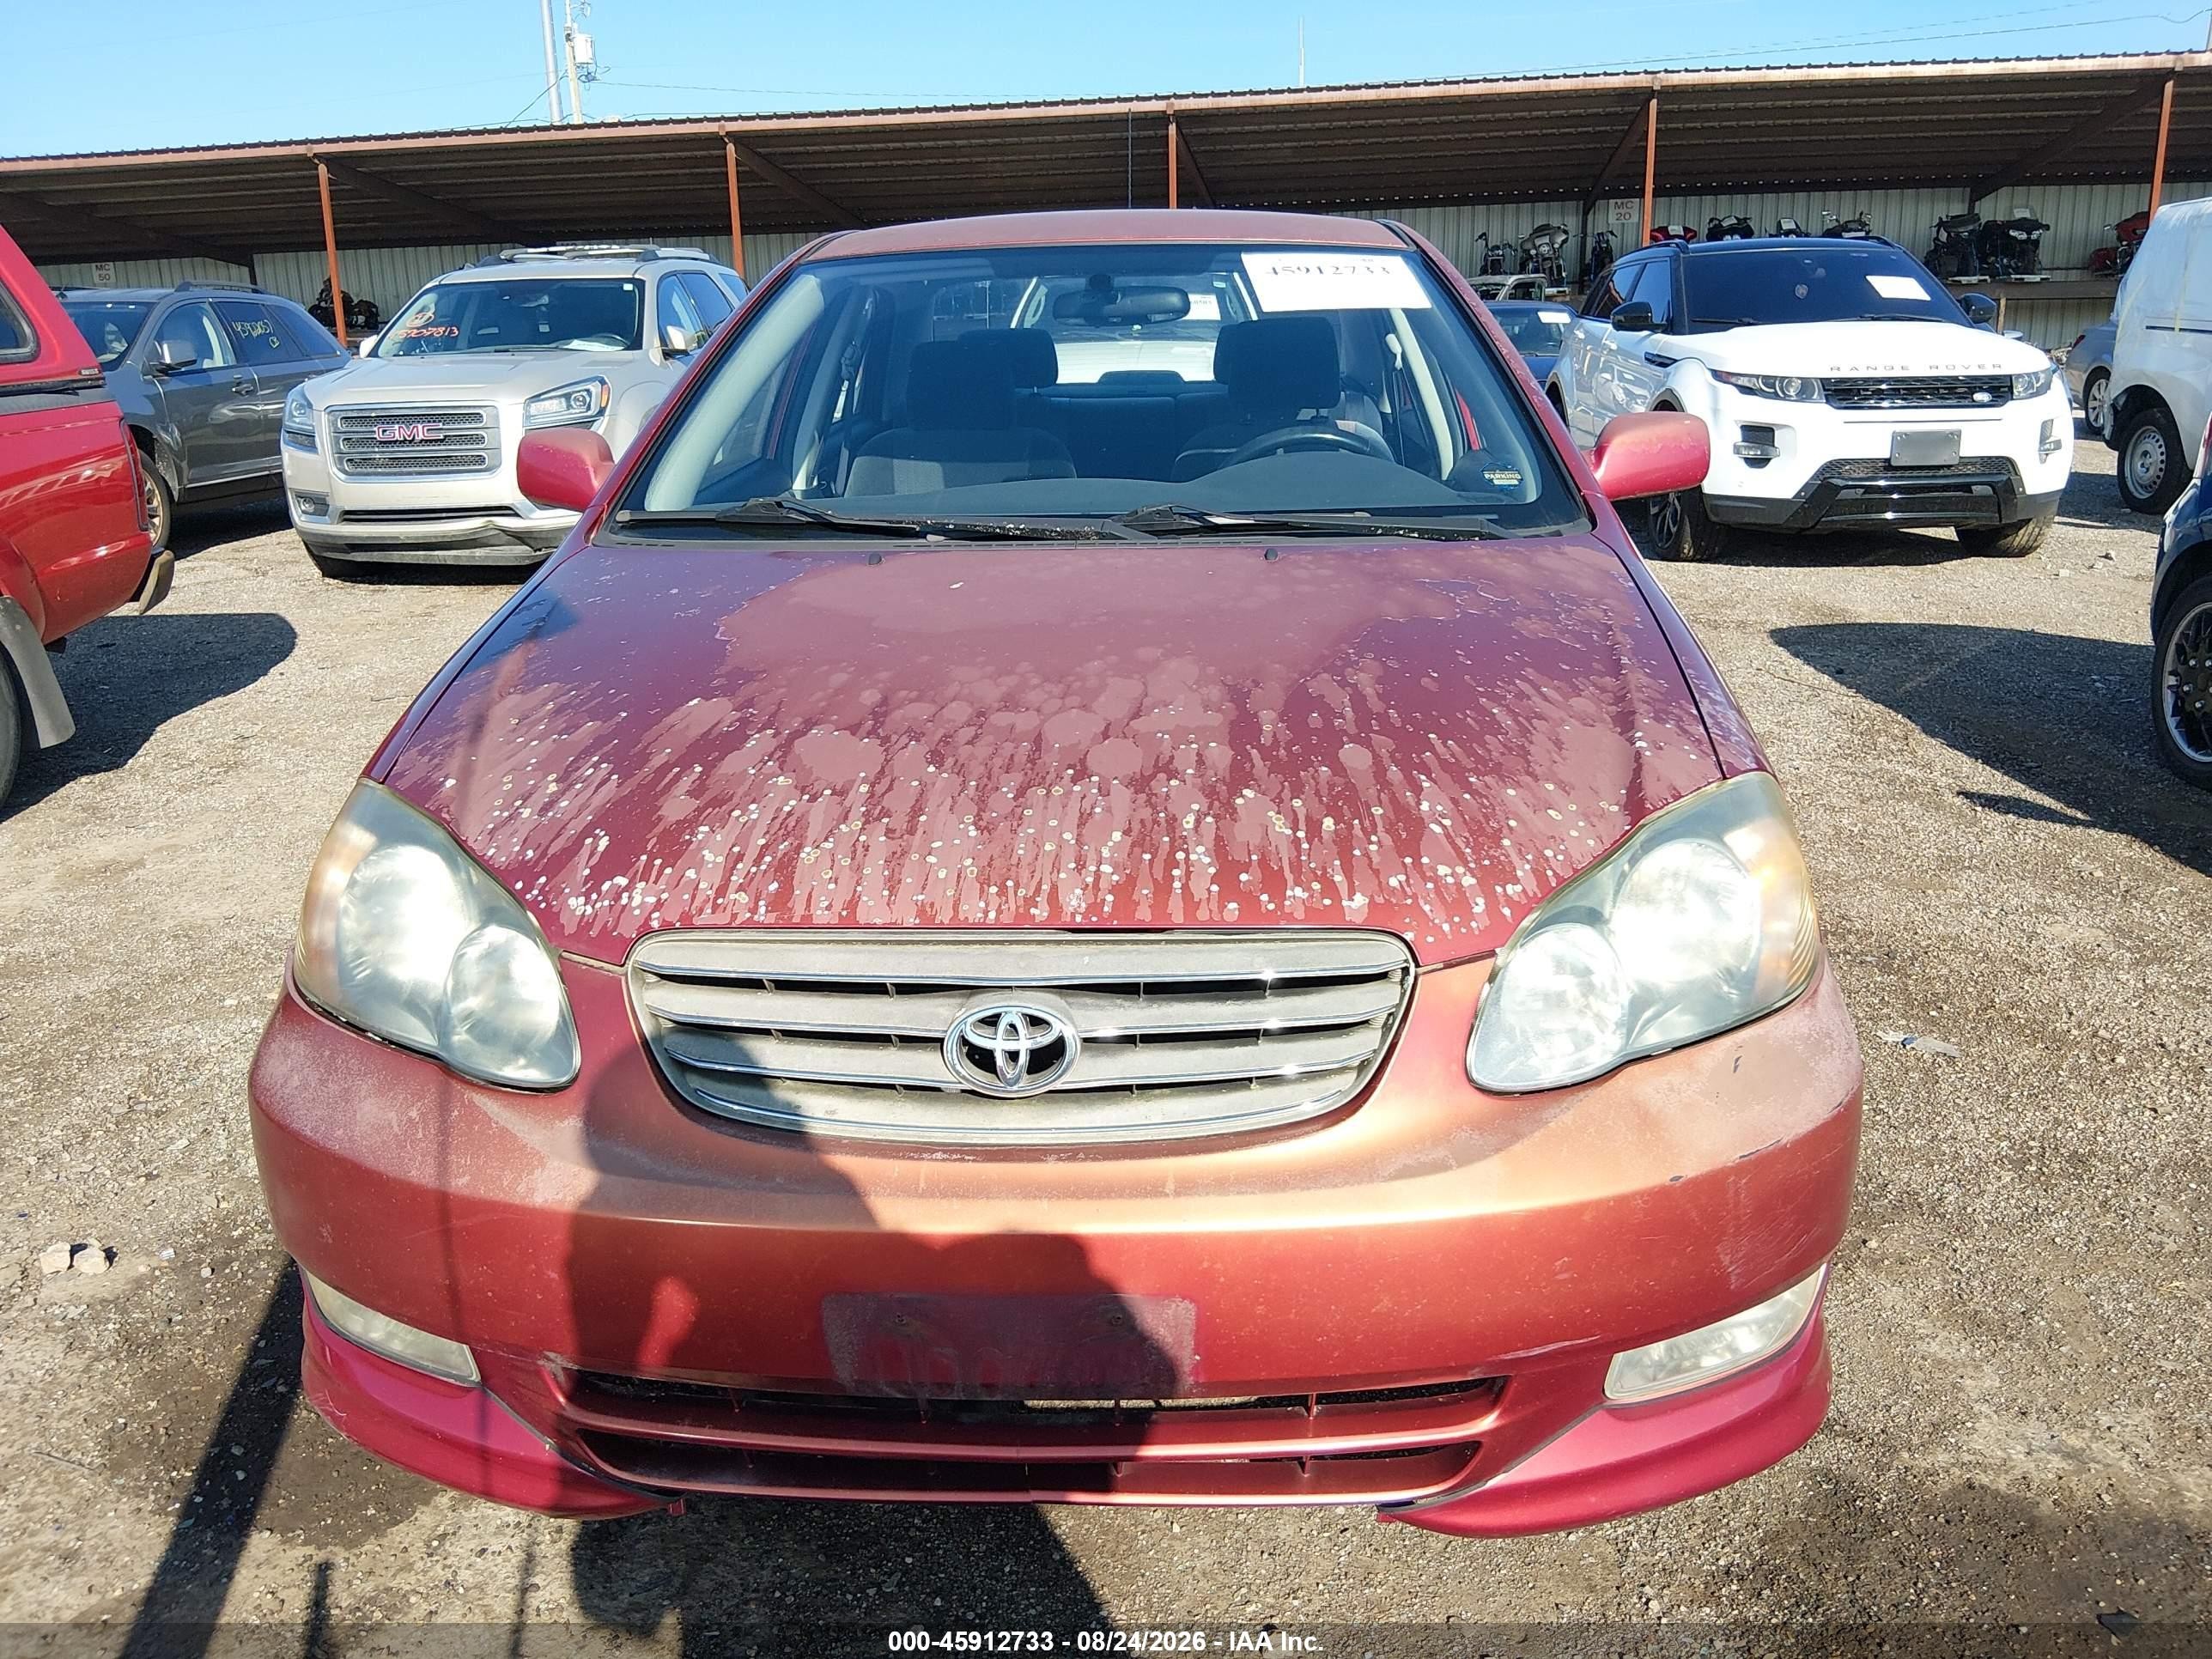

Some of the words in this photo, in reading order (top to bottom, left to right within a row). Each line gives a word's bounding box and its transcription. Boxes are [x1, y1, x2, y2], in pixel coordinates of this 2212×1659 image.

[1614, 200, 1634, 210] MC
[1615, 212, 1632, 221] 20
[375, 423, 443, 440] GMC
